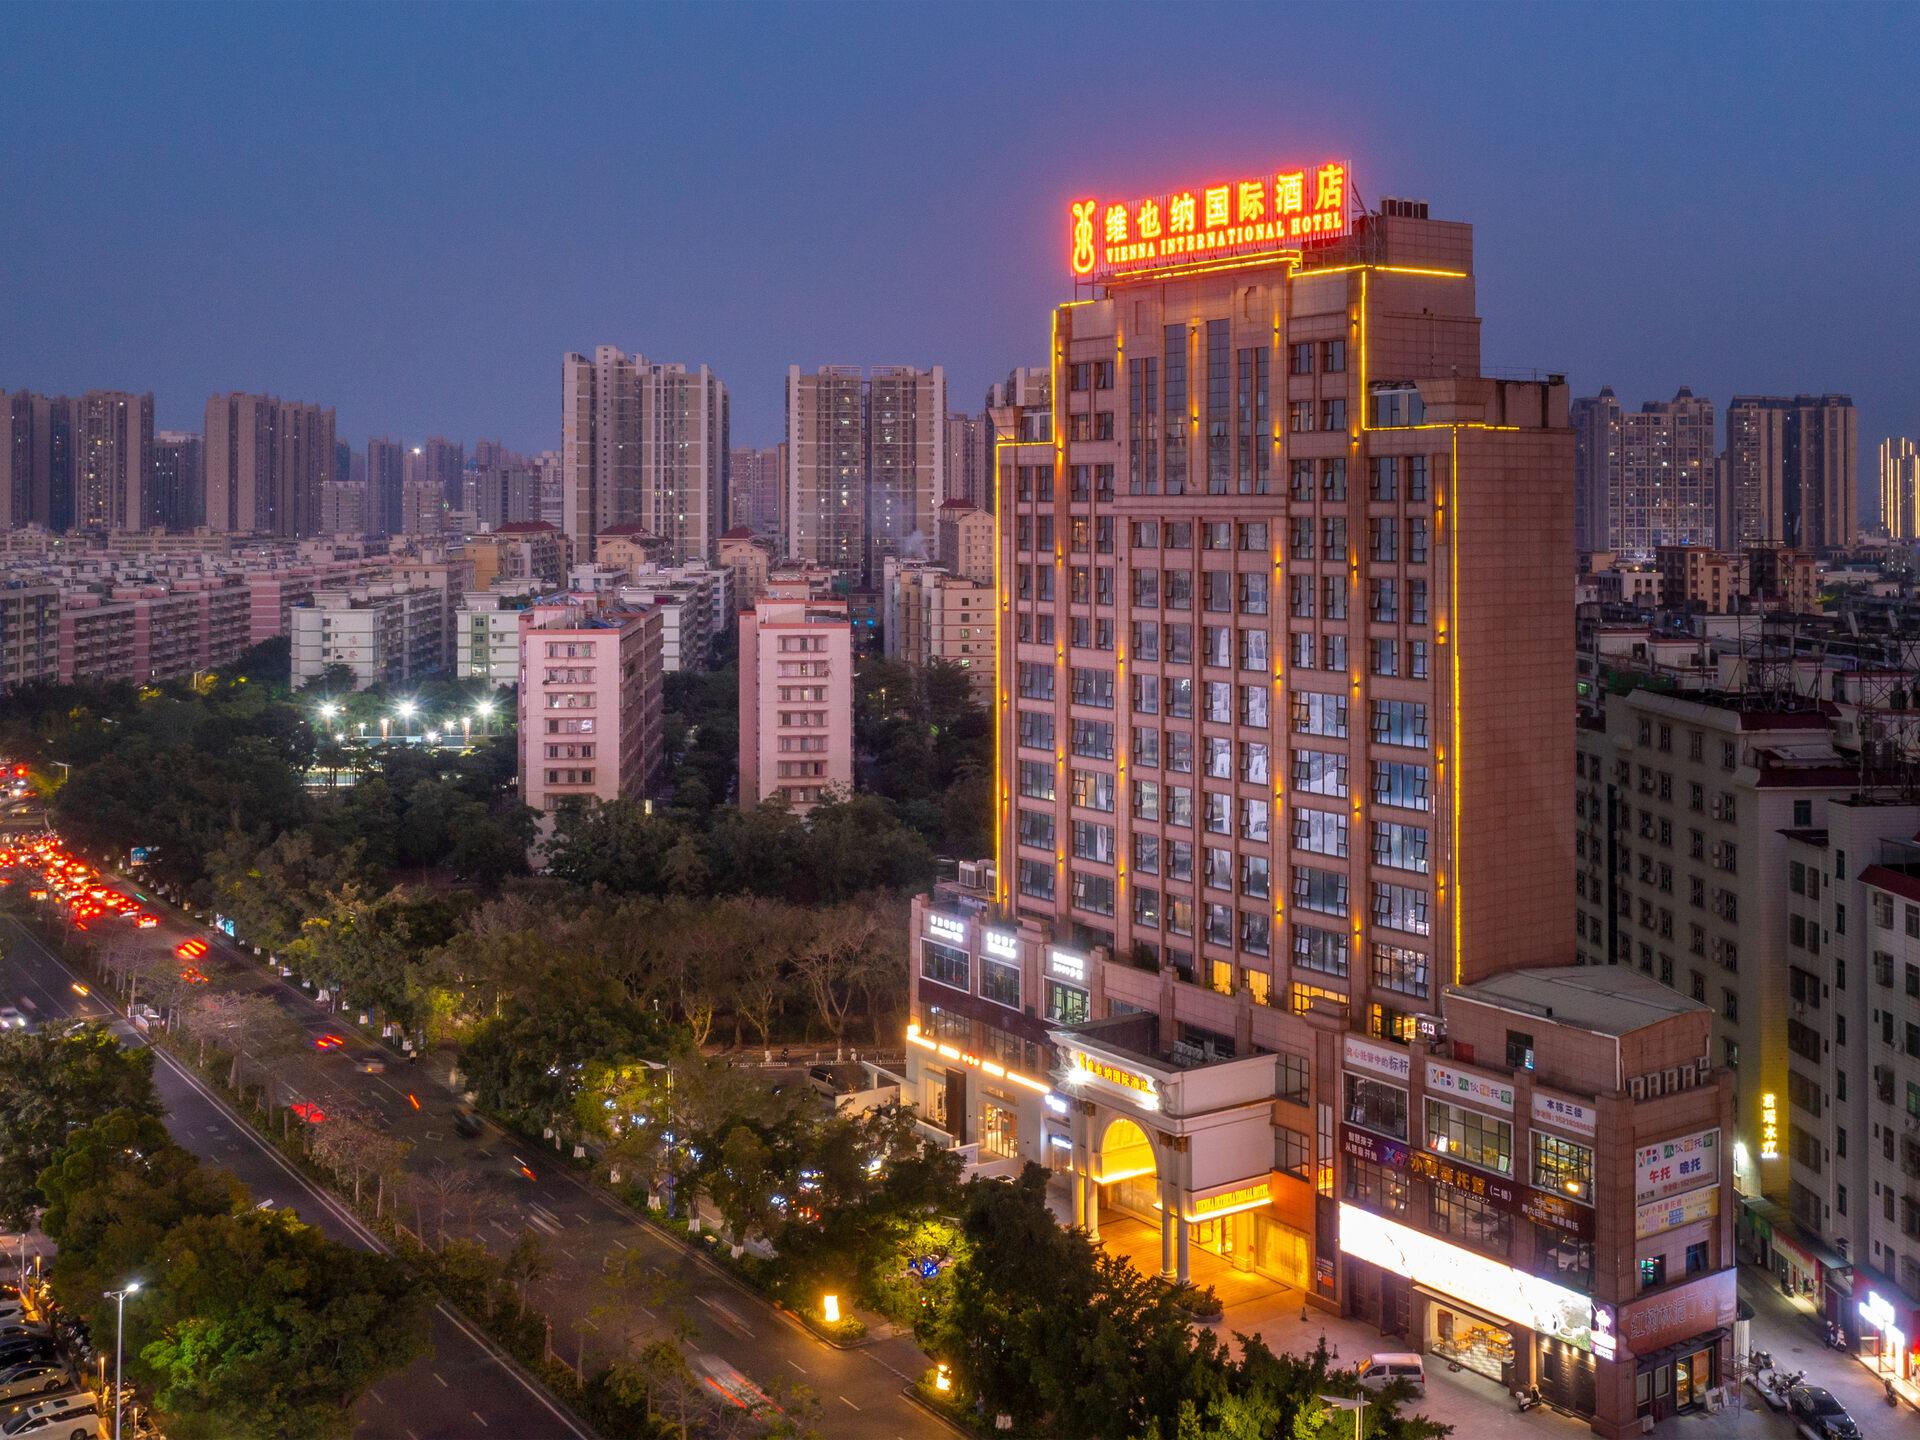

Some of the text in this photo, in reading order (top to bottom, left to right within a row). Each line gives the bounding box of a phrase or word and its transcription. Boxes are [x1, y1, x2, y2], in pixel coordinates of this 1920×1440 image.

[1105, 164, 1343, 243] 维也纳国际酒店
[1106, 212, 1342, 264] VIENNA INTERNATIONAL HOTEL
[1087, 1058, 1151, 1094] 维也纳国际酒店
[1649, 1166, 1671, 1184] 午托
[1680, 1157, 1701, 1175] 晚托
